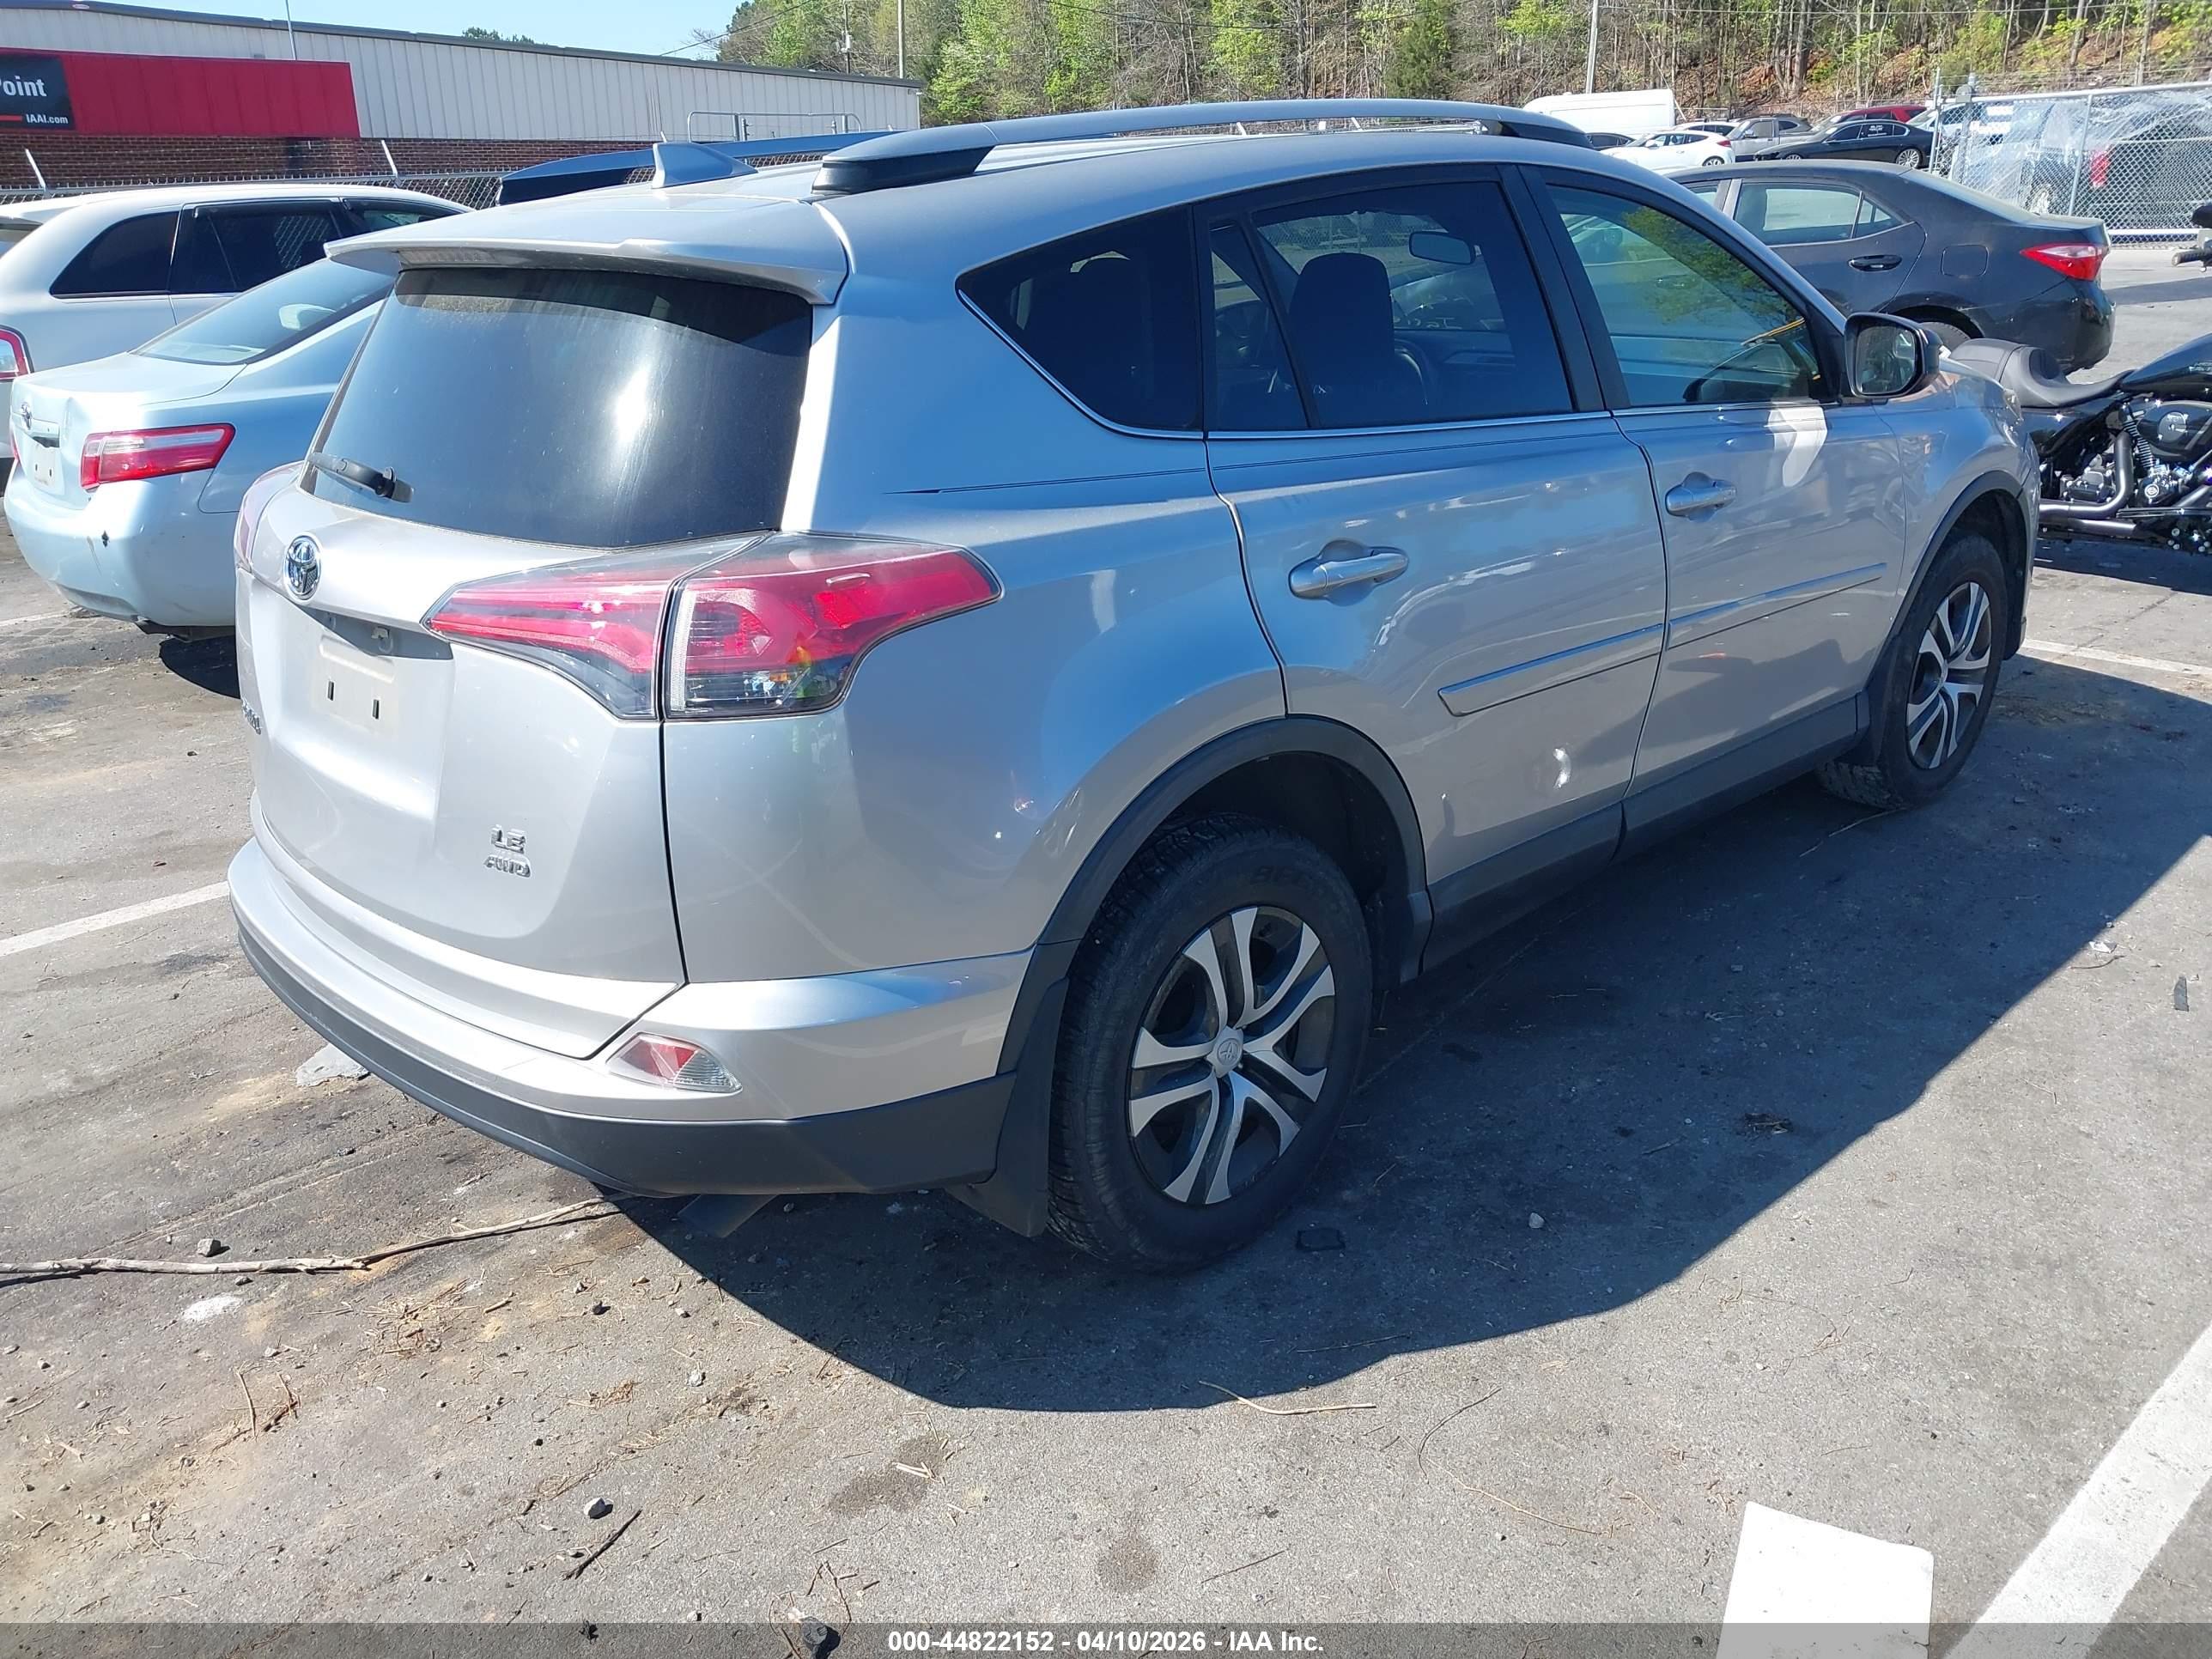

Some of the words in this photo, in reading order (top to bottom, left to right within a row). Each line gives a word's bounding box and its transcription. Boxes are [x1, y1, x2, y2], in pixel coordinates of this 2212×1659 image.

[0, 75, 47, 96] oint
[26, 113, 69, 124] IAAI.com
[490, 823, 526, 854] LE
[483, 854, 532, 878] AWD
